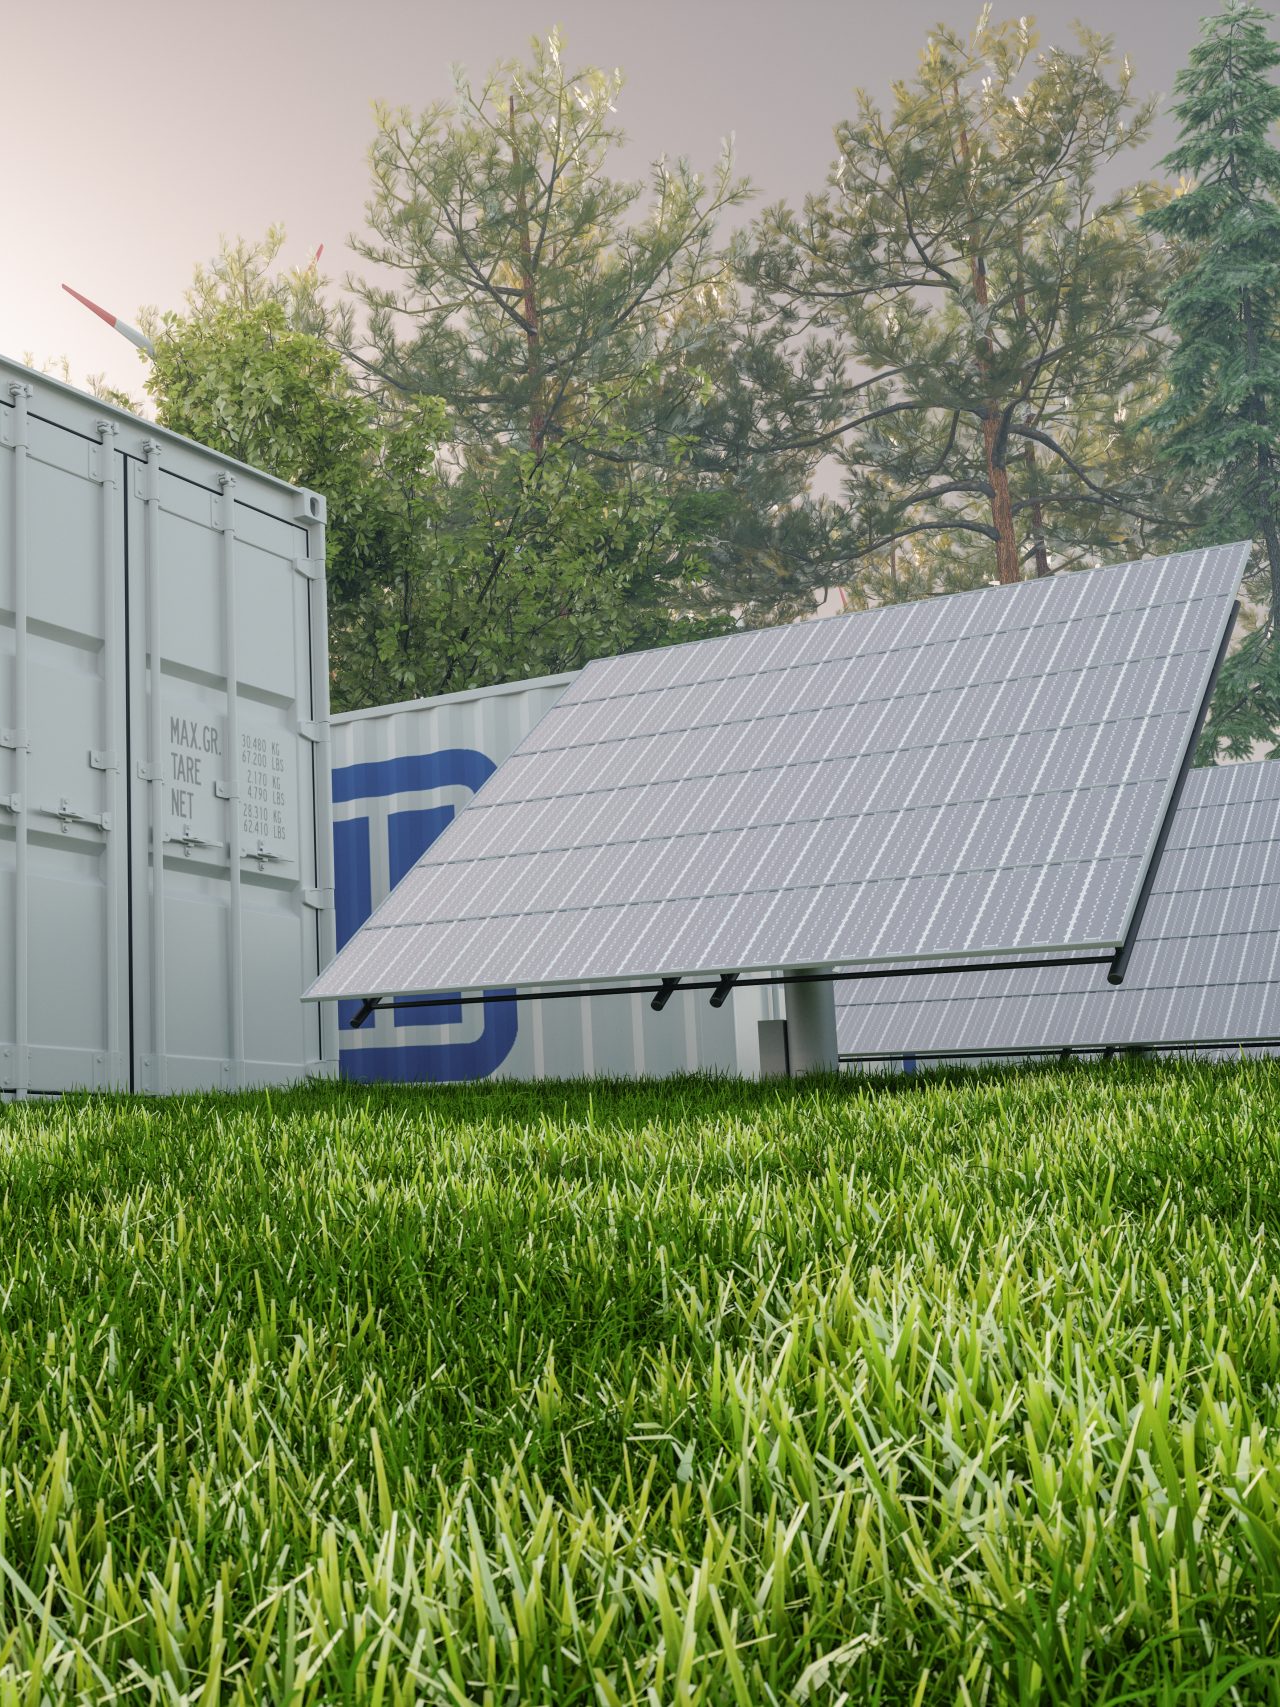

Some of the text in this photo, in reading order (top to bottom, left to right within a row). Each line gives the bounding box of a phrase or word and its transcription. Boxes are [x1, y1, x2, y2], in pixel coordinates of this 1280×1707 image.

[170, 716, 222, 756] MAX.GR.
[271, 741, 280, 756] KG
[171, 752, 202, 786] TARE
[271, 758, 284, 773] LBS
[272, 776, 281, 791] KG
[171, 788, 194, 820] NET
[272, 791, 285, 807] LBS
[273, 810, 282, 825] KG
[273, 825, 286, 841] LBS
